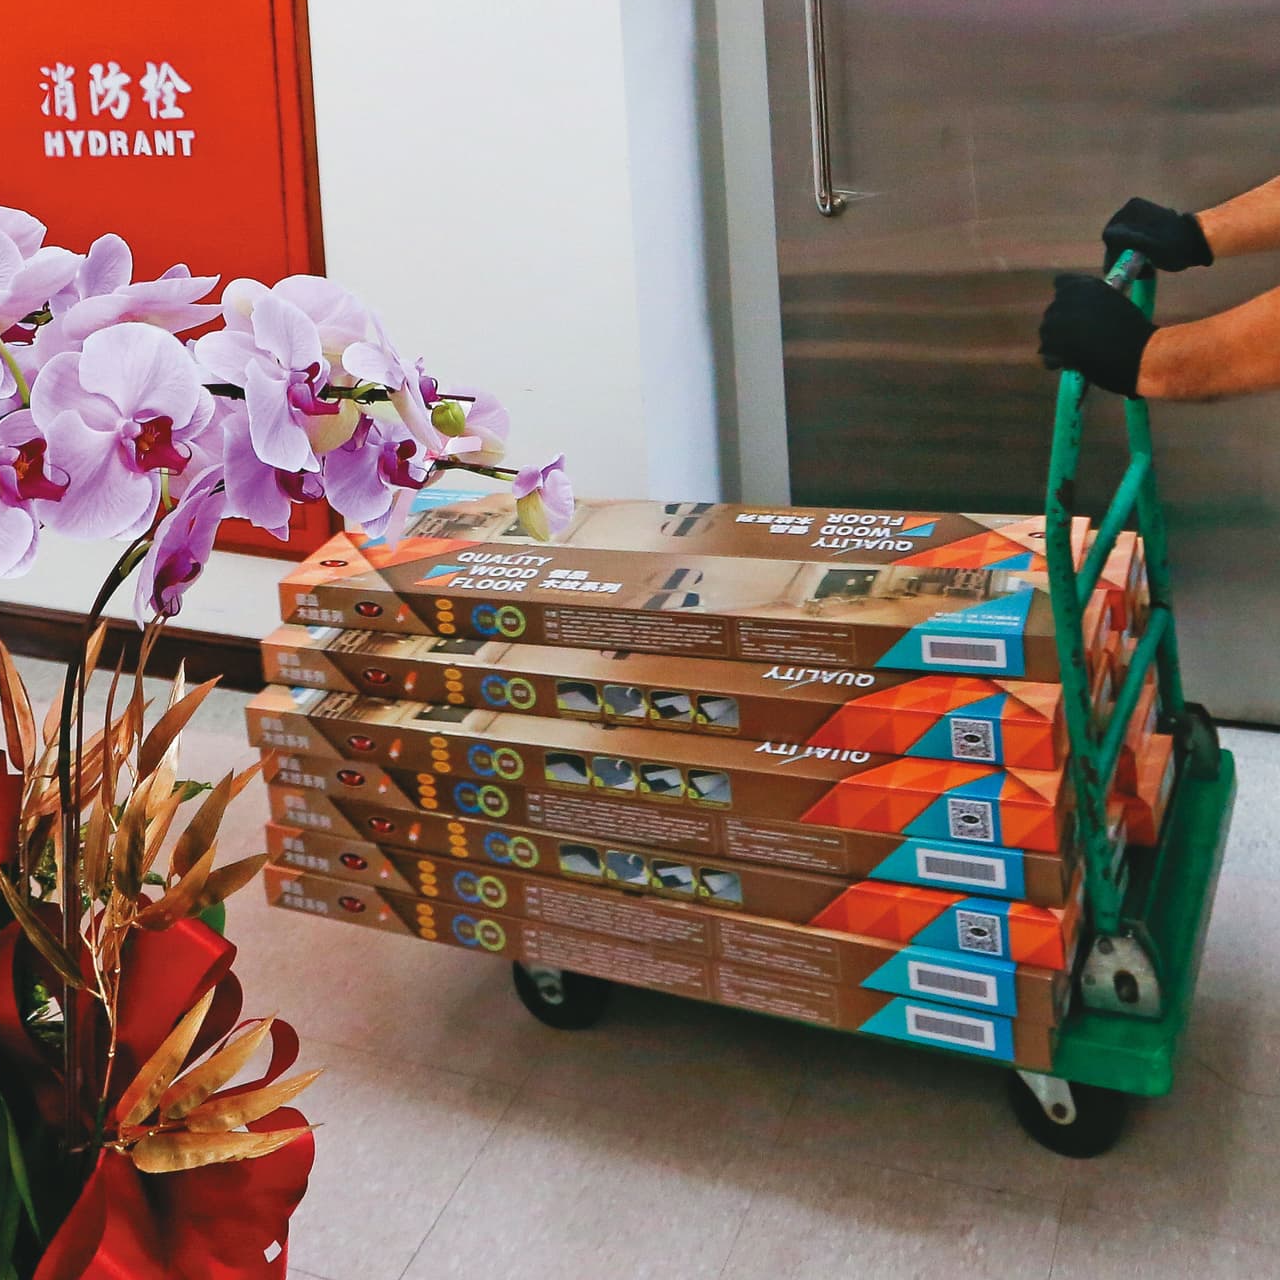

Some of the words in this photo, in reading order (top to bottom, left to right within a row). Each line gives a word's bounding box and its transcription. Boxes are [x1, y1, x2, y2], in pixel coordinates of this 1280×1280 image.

[39, 61, 193, 122] 消防栓
[43, 129, 196, 157] HYDRANT
[826, 513, 906, 526] FLOOR
[820, 525, 893, 538] WOOD
[810, 536, 914, 554] QUALITY
[456, 551, 554, 568] QUALITY
[470, 565, 538, 580] WOOD
[447, 577, 528, 593] FLOOR
[761, 665, 876, 689] QUALITY
